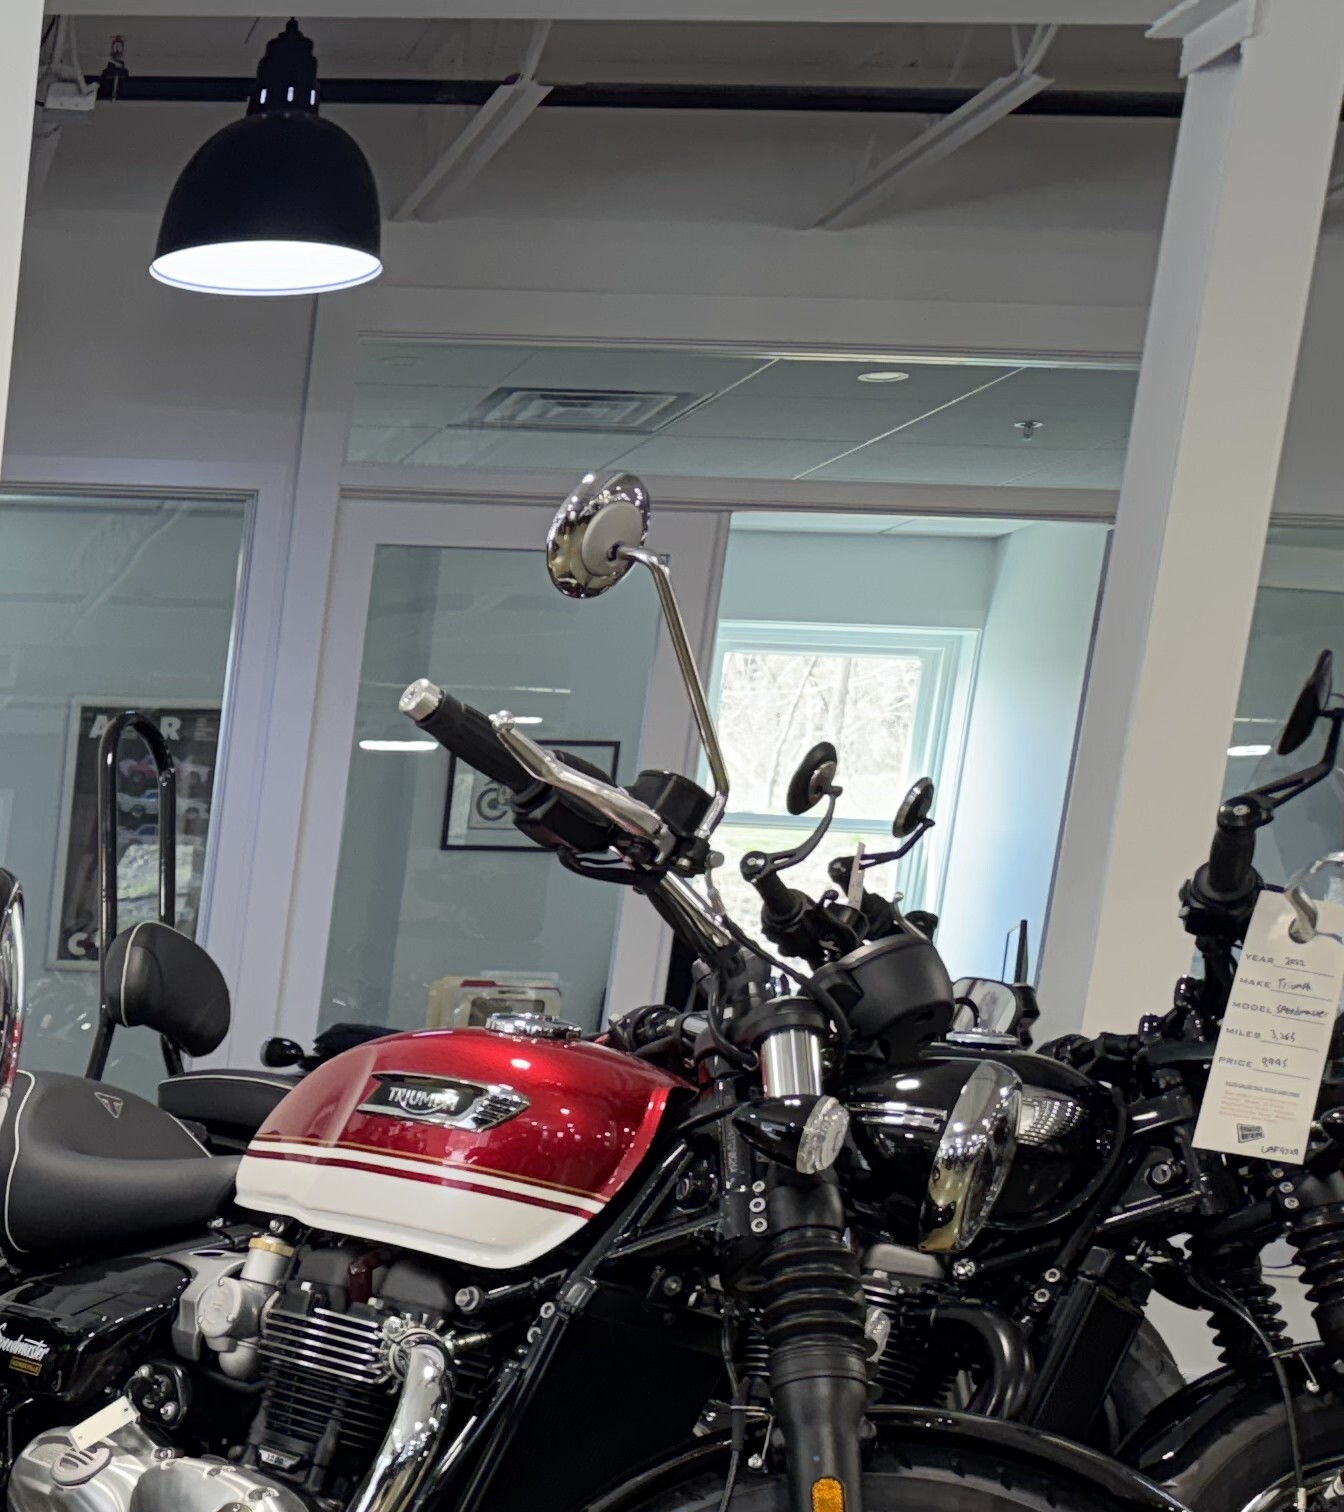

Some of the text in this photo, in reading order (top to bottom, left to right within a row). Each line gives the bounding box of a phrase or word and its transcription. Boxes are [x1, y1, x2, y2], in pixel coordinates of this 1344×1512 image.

[1245, 953, 1275, 964] YEAR
[1239, 977, 1272, 989] MAKE
[1231, 1001, 1273, 1014] MODEL
[1225, 1027, 1261, 1039] MILES
[1218, 1056, 1254, 1068] PRICE
